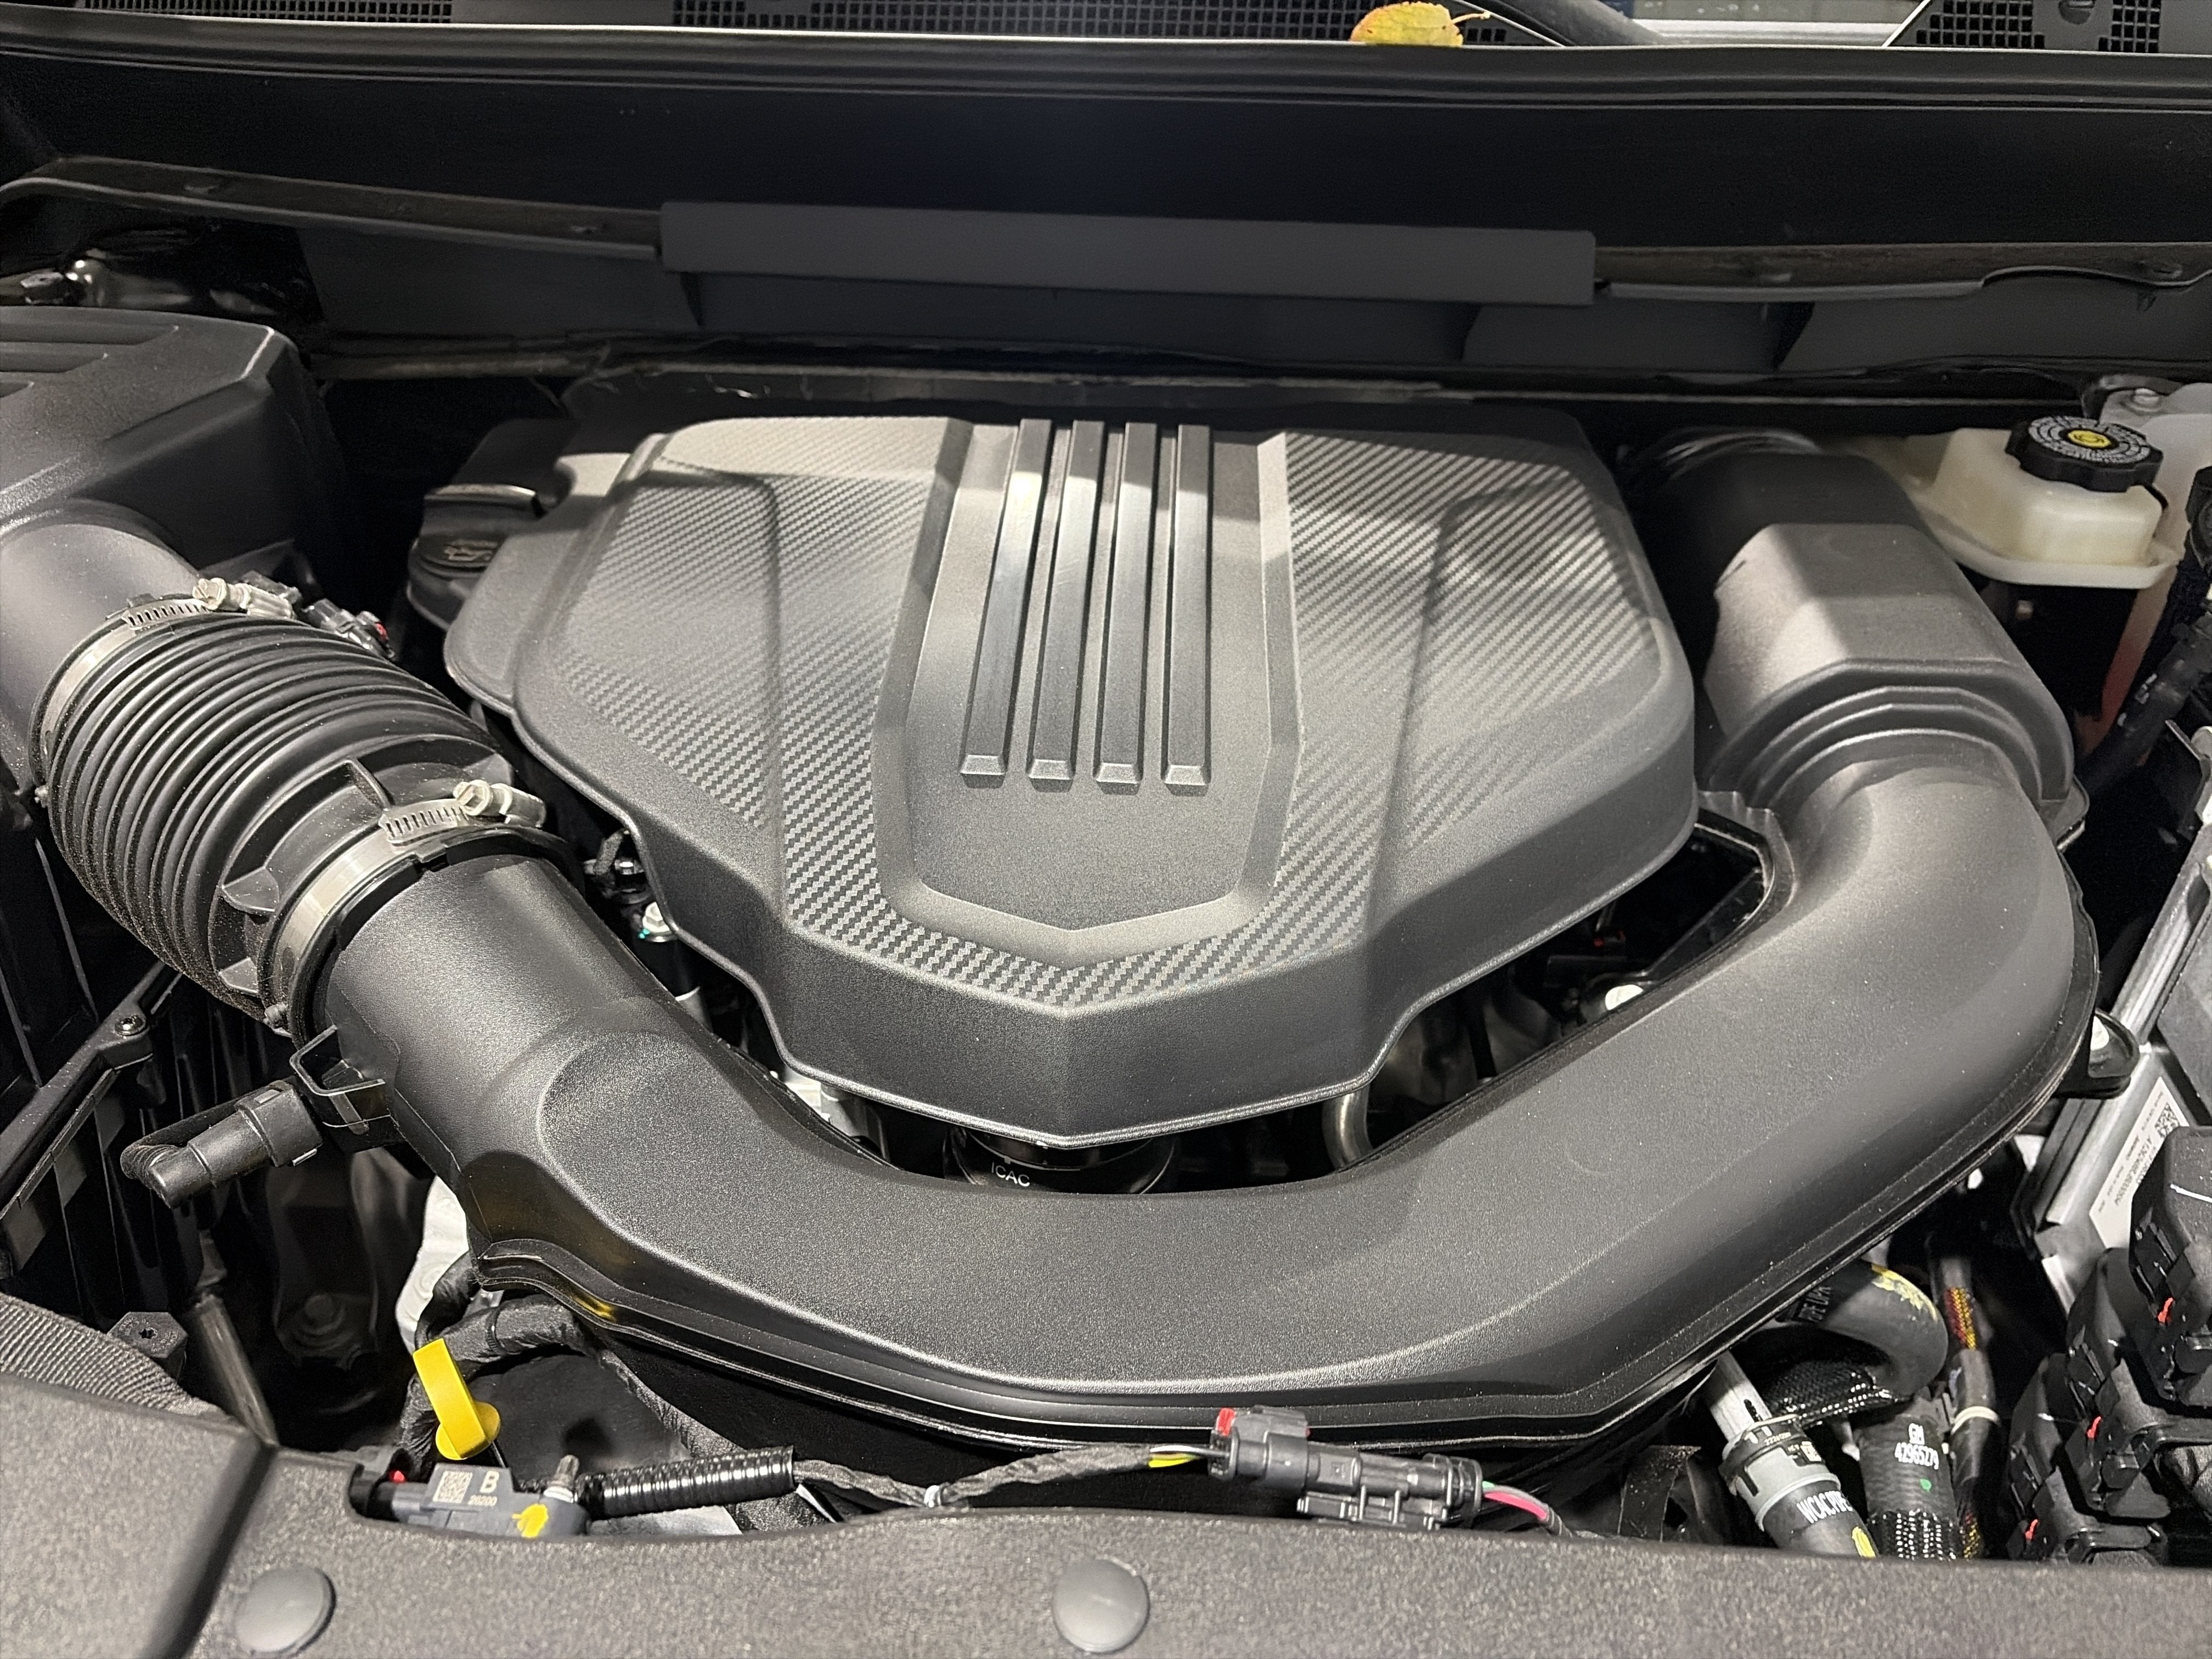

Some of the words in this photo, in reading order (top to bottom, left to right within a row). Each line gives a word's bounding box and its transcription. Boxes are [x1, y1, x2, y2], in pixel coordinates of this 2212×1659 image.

[991, 1162, 1030, 1187] ICAC
[1908, 1423, 1925, 1444] GM
[479, 1470, 500, 1493] B
